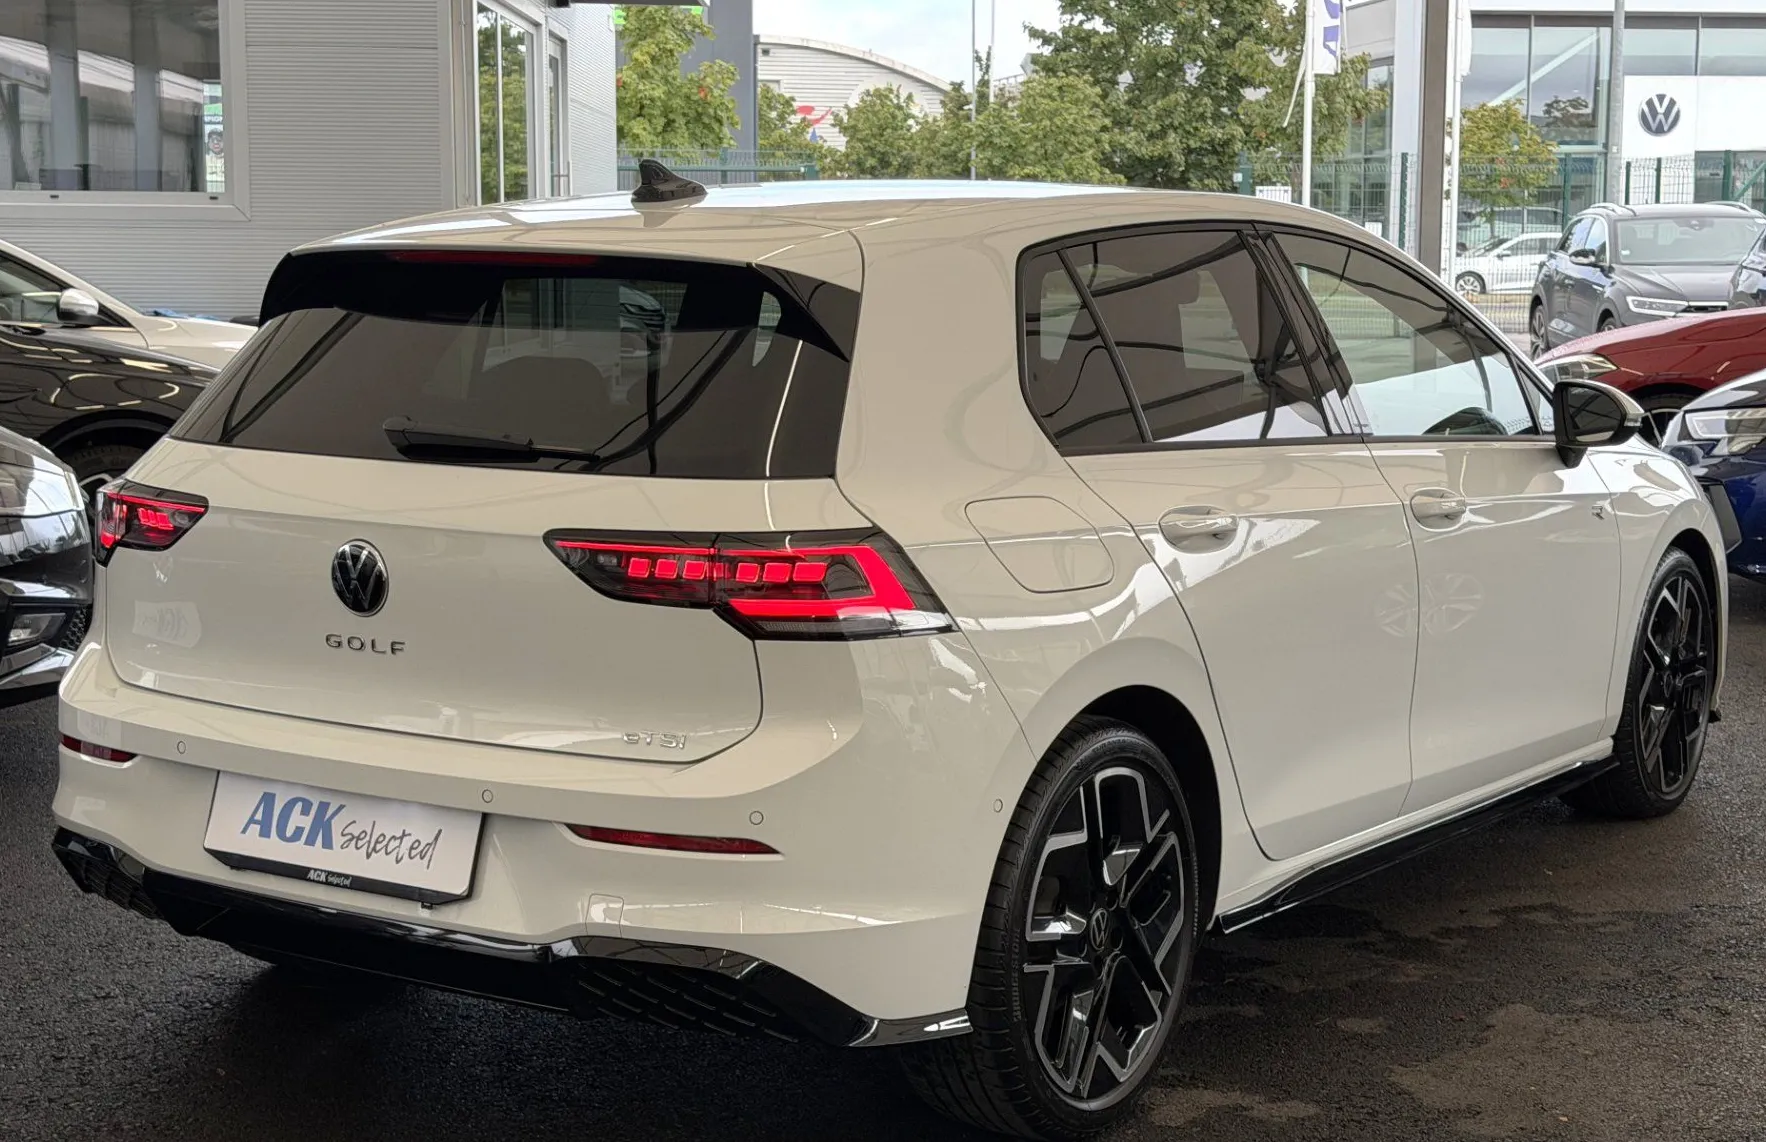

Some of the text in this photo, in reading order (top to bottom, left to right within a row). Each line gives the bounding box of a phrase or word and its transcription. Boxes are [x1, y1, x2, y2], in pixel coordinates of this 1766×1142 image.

[1638, 93, 1681, 136] VW
[332, 540, 387, 614] VW
[325, 633, 406, 655] GOLF
[240, 790, 443, 870] ACK Selected
[307, 869, 328, 882] ACK
